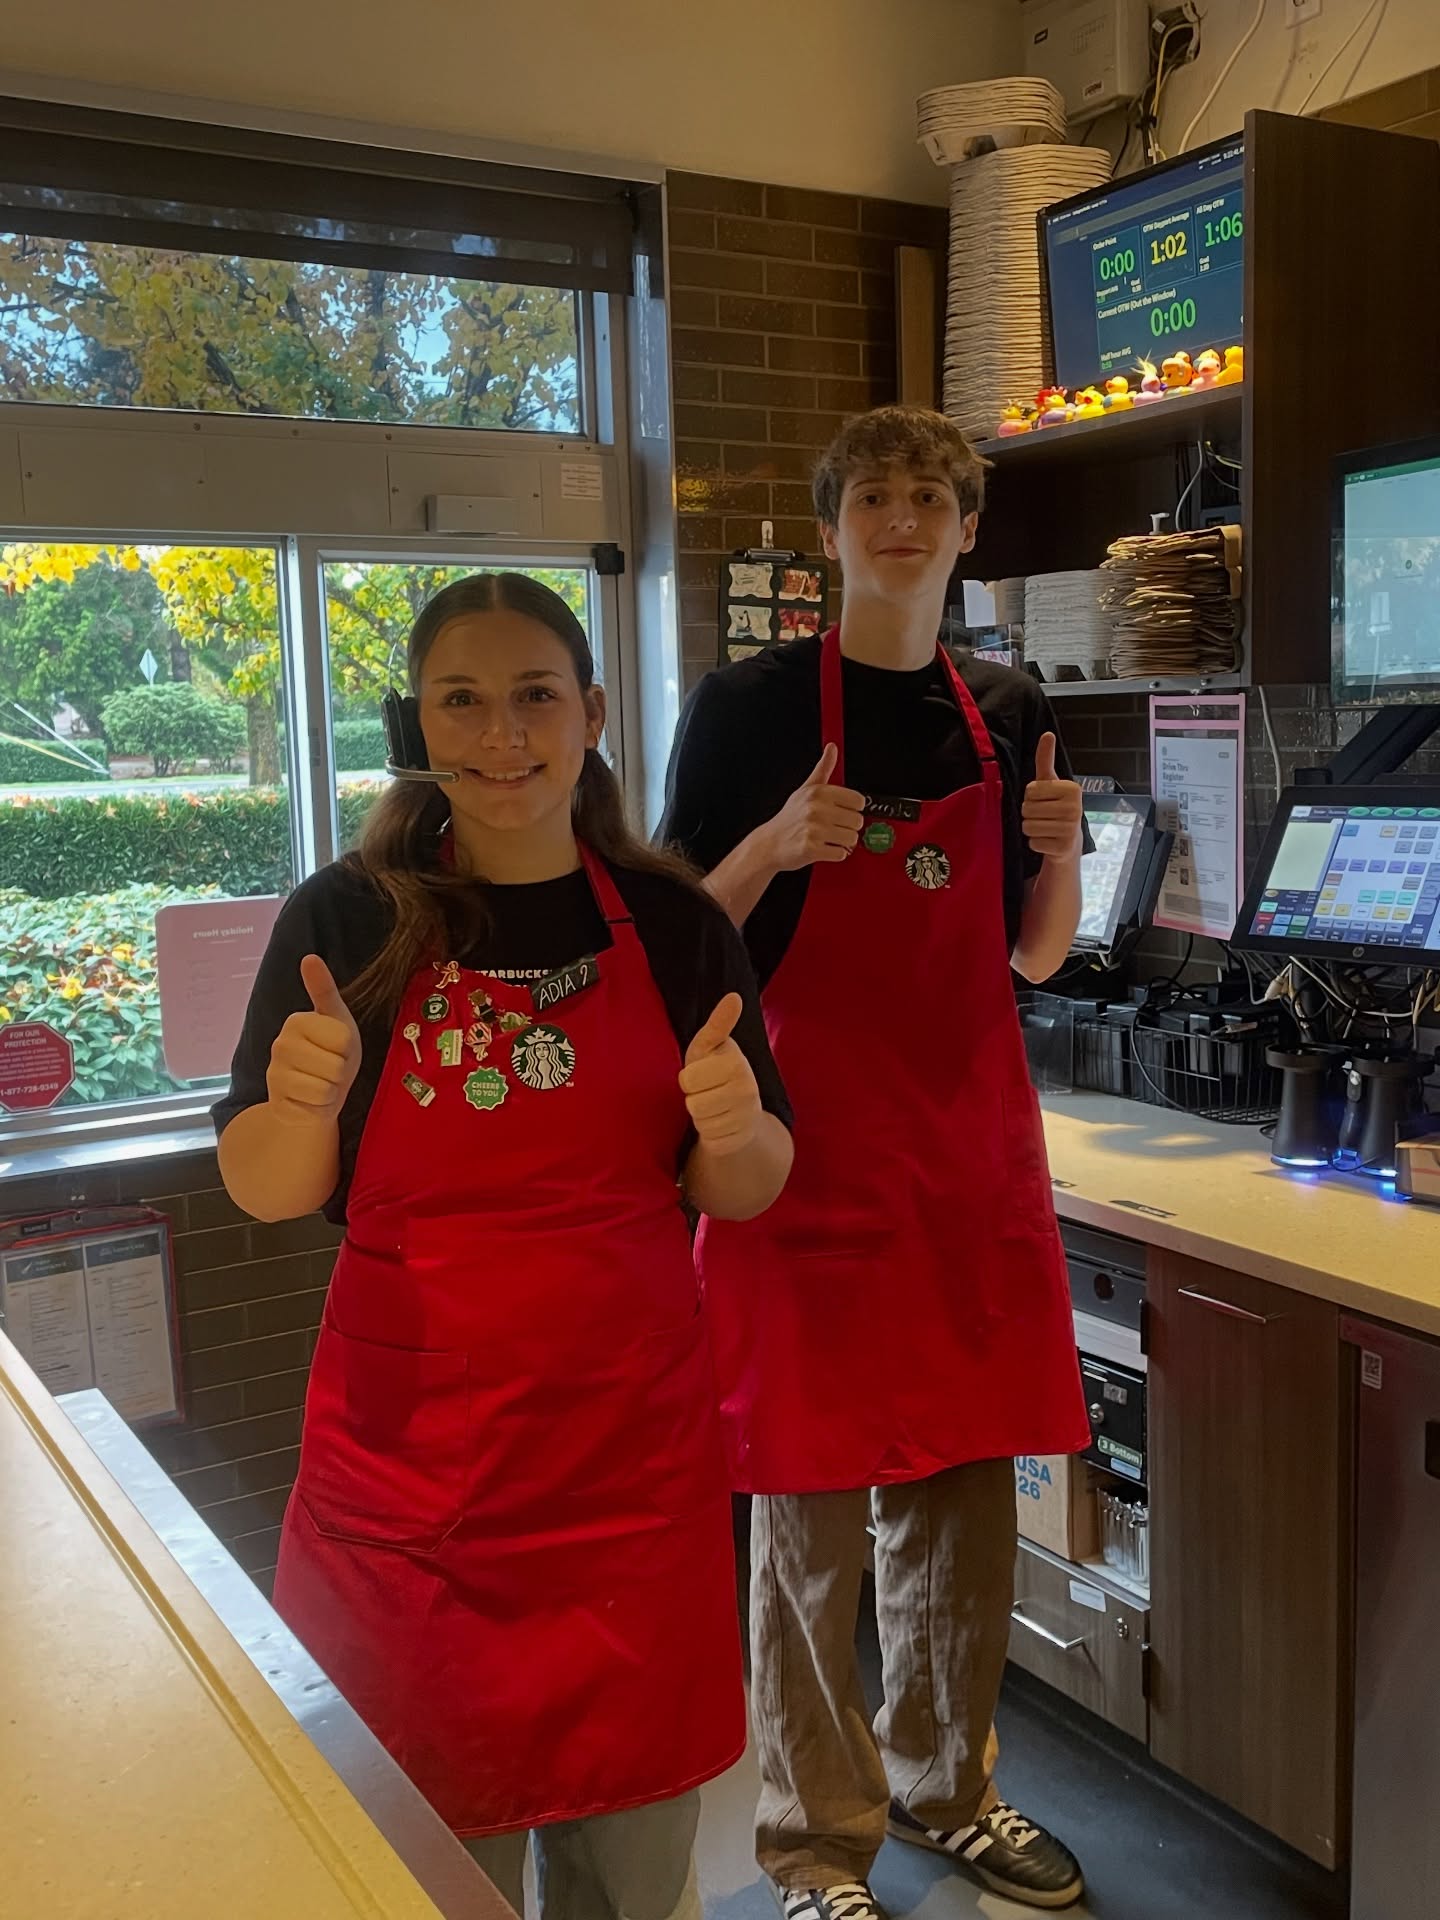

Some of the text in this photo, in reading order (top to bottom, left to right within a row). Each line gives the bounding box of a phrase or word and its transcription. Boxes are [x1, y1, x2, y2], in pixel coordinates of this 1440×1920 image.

[1204, 211, 1243, 248] 1:06
[1150, 231, 1188, 265] 1:02
[1100, 249, 1135, 280] 0:00
[1097, 306, 1118, 319] Current
[1150, 298, 1196, 337] 0:00
[475, 969, 550, 979] TARBUCK
[4, 1038, 46, 1048] PROTECTION
[10, 1031, 23, 1039] FOR
[471, 1081, 500, 1090] CHEERS
[472, 1089, 499, 1097] TO YOU
[1109, 1443, 1140, 1464] Bottom
[1015, 1455, 1052, 1486] USA
[1018, 1475, 1041, 1501] 26
